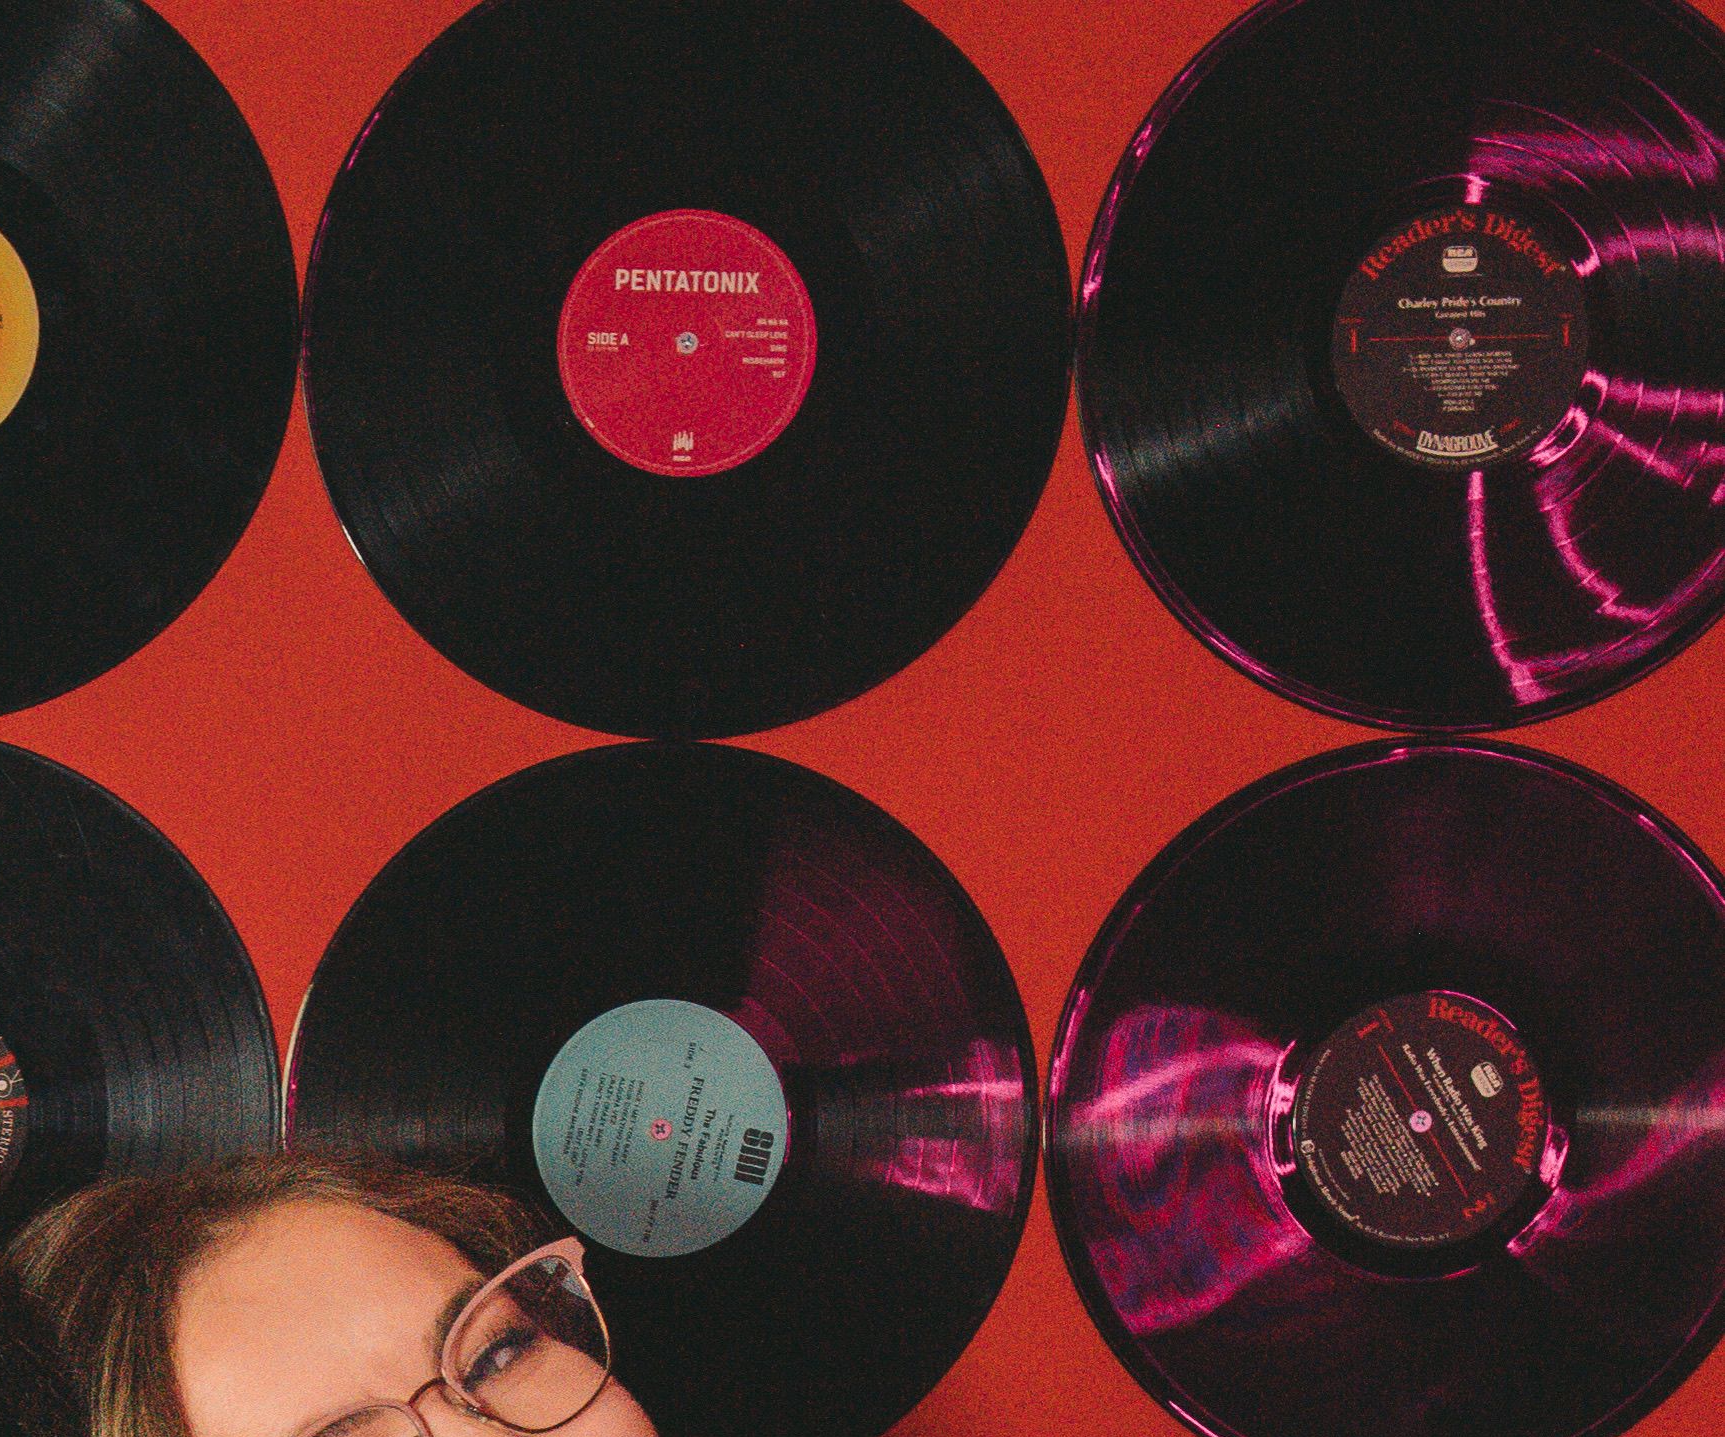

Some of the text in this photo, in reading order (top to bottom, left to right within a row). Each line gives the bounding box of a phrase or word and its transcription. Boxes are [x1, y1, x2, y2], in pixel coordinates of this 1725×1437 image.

[1358, 209, 1562, 281] Reader's Digest
[614, 268, 760, 295] PENTATONIX
[1479, 296, 1523, 308] Country
[587, 332, 630, 346] SIDE A
[1423, 1046, 1491, 1150] When Radio Was King
[1428, 996, 1545, 1172] Reader's Digest
[1482, 1063, 1502, 1088] RCA
[664, 1075, 704, 1201] FREDDY FENDER
[689, 1107, 716, 1181] The Fabulous
